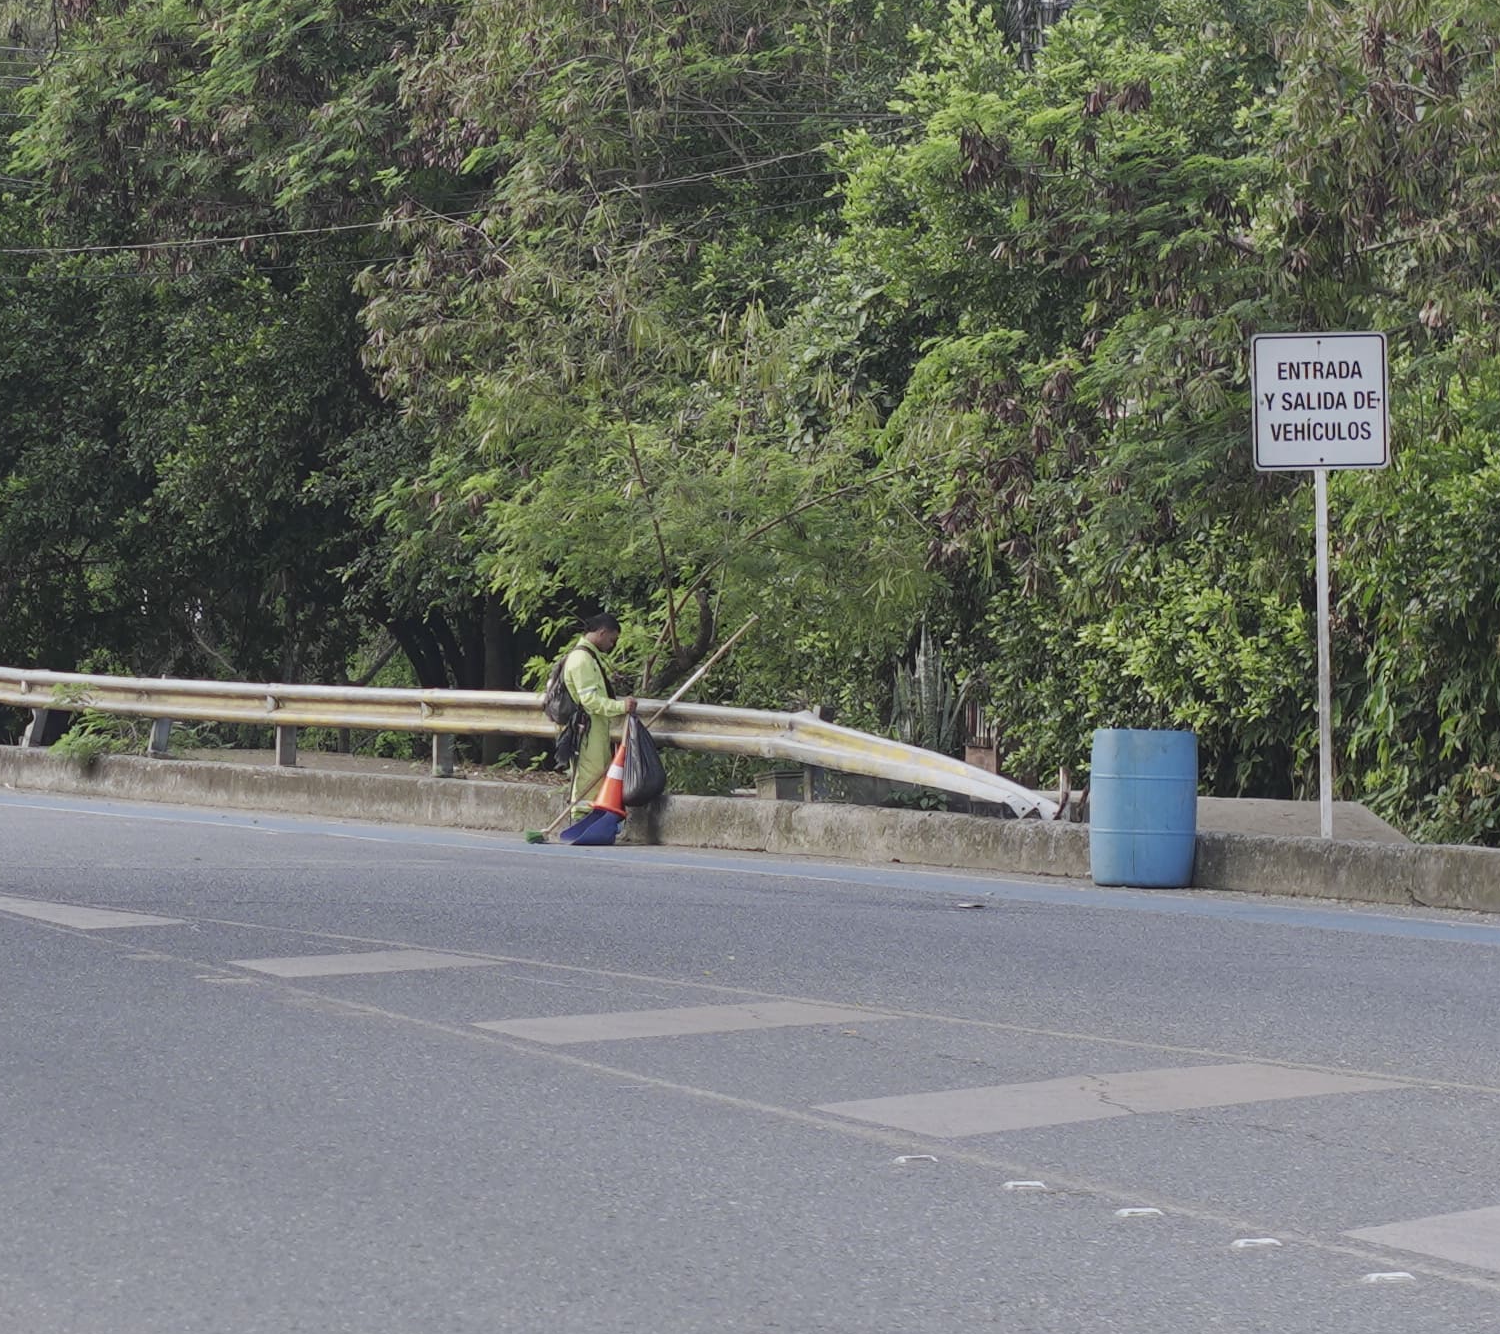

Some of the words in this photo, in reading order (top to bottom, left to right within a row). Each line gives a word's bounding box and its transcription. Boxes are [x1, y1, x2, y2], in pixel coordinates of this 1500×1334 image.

[1277, 360, 1363, 380] ENTRADA
[1264, 392, 1275, 411] Y
[1281, 391, 1348, 411] SALIDA
[1353, 390, 1377, 410] DE
[1270, 417, 1372, 442] VEHÍCULOS
